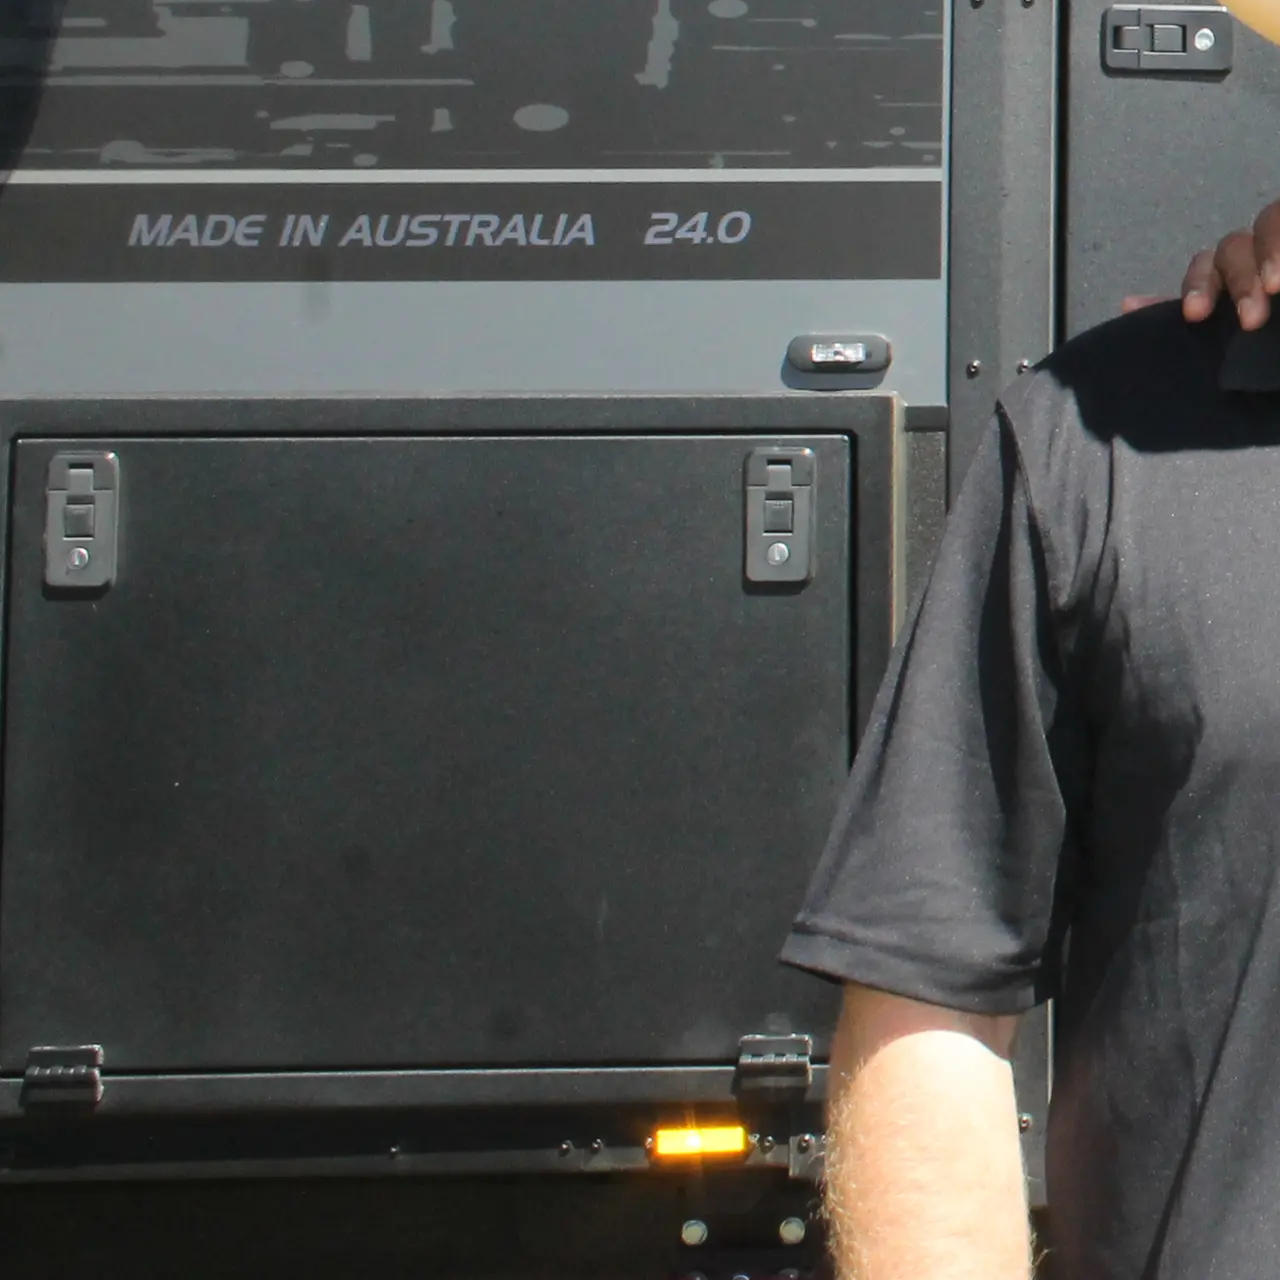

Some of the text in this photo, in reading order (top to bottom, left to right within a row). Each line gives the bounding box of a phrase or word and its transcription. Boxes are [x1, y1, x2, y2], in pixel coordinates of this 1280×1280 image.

[127, 211, 752, 247] MADE IN AUSTRALIA 24.0
